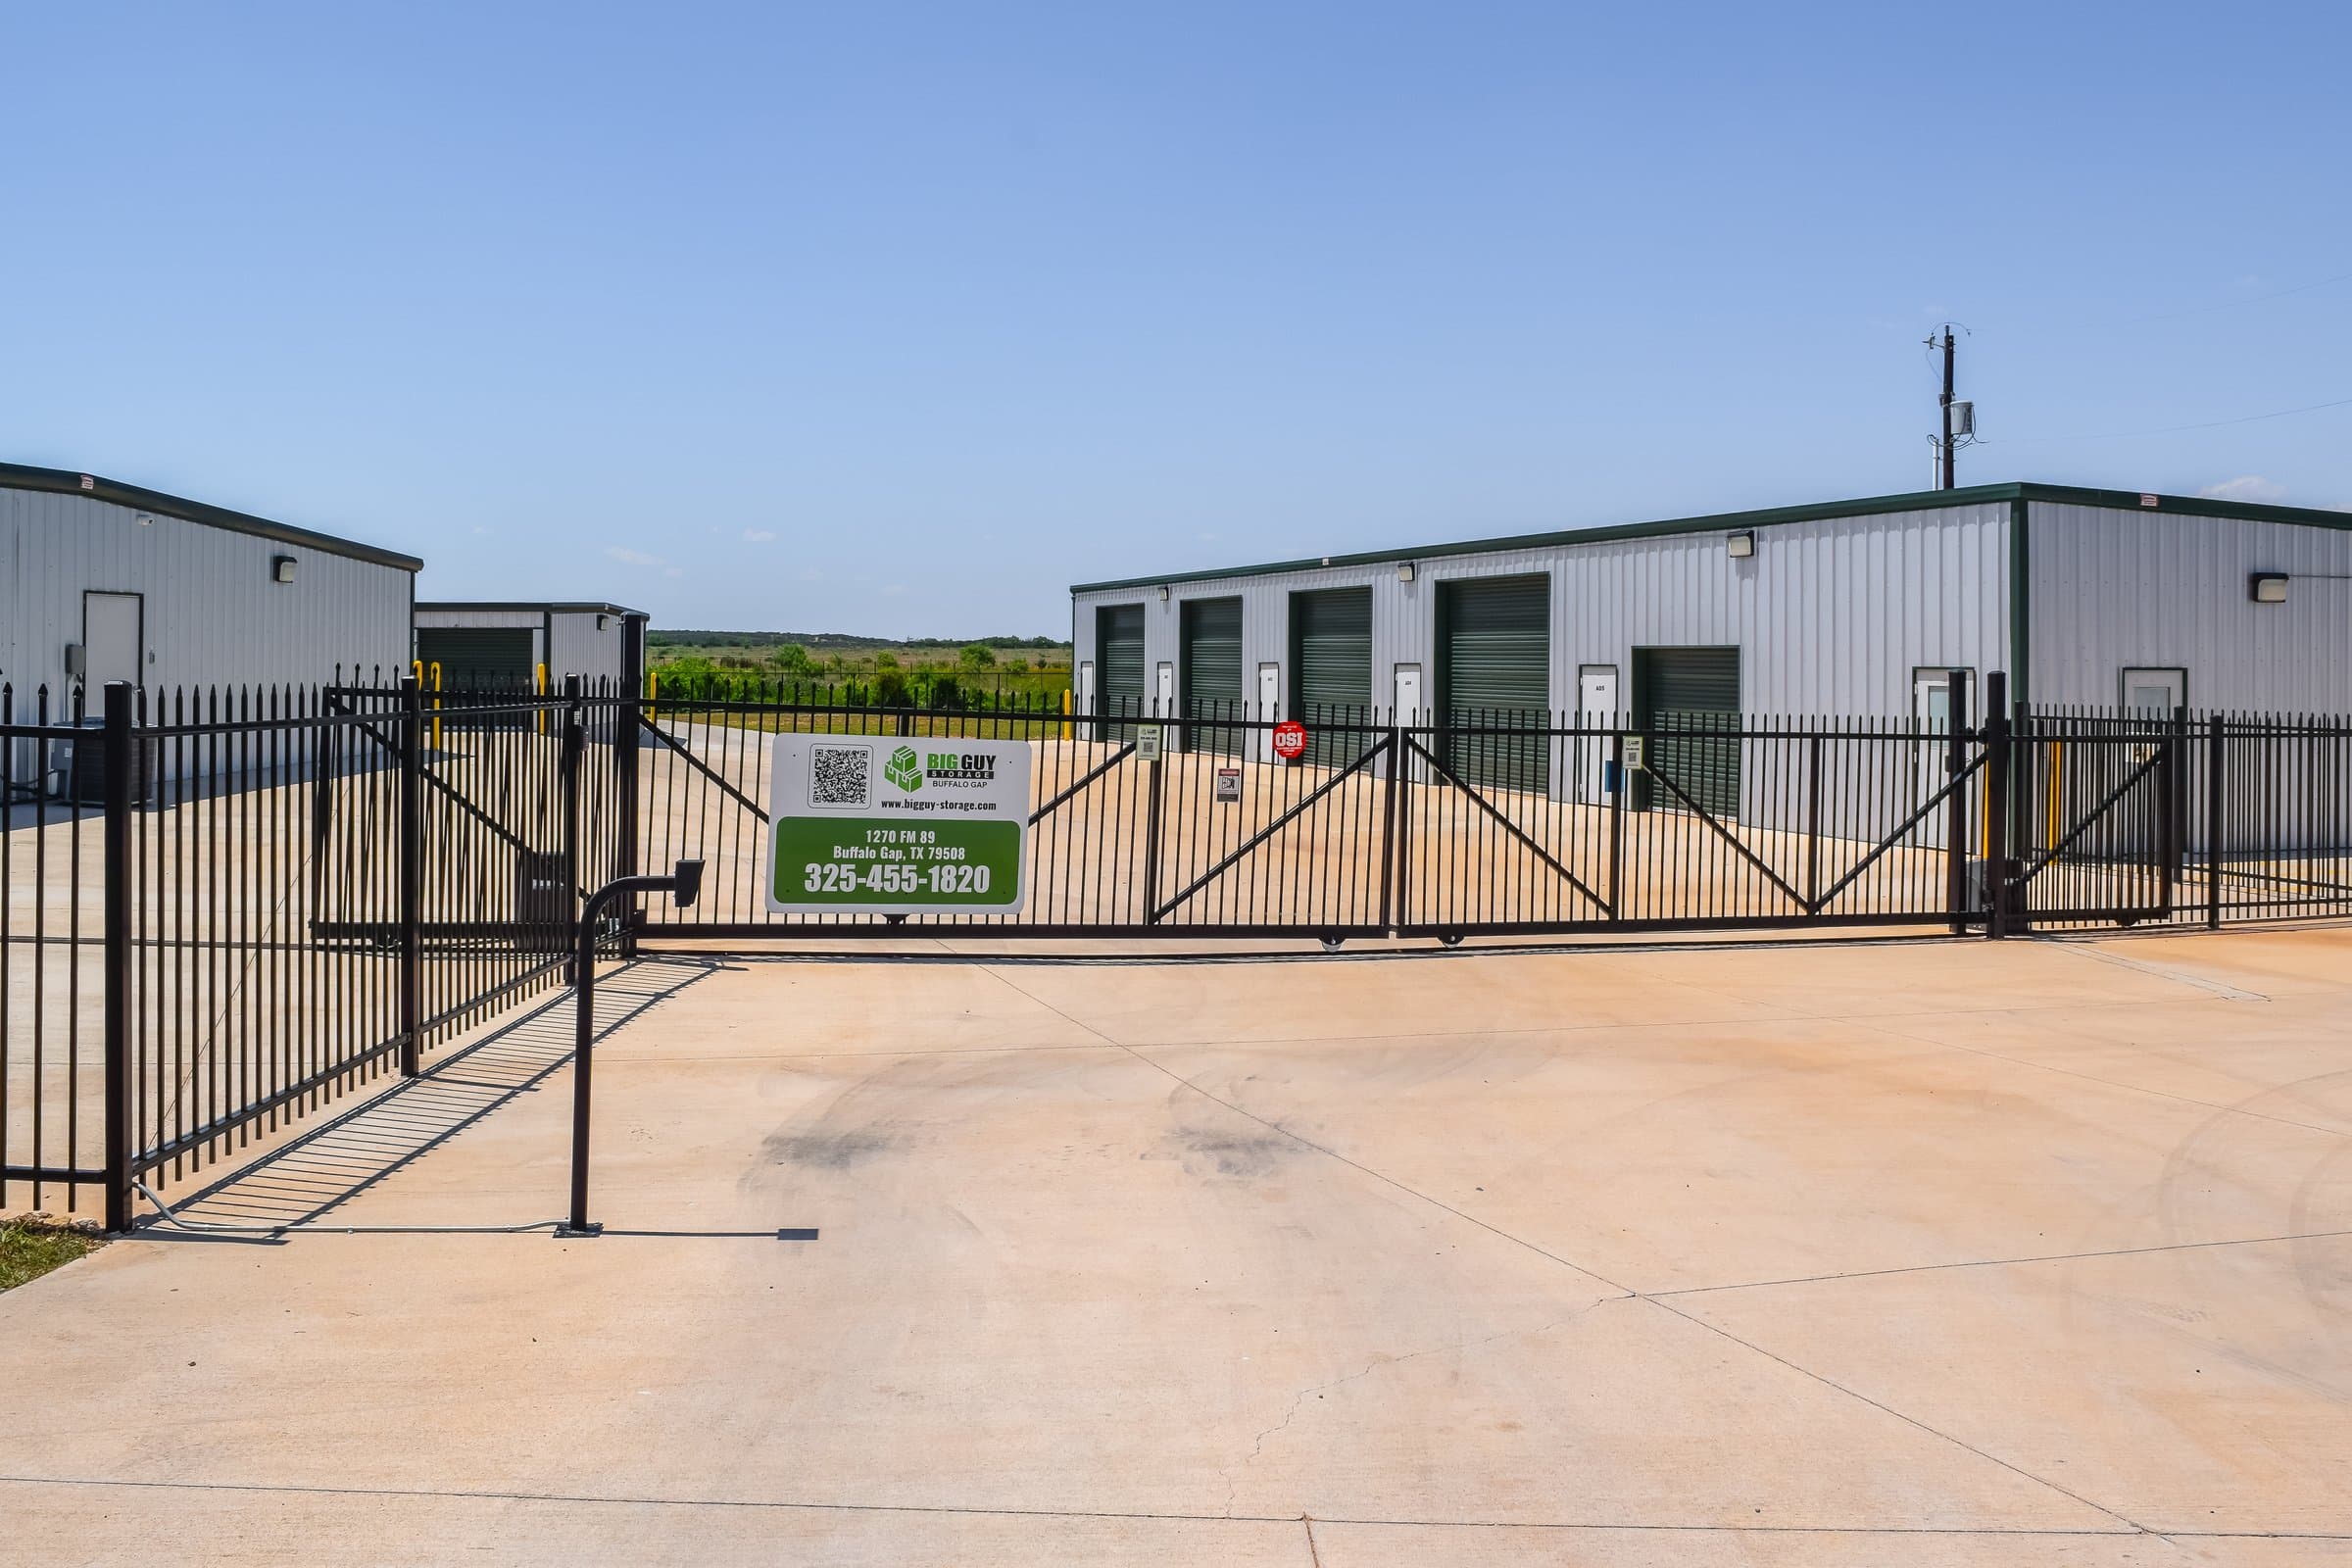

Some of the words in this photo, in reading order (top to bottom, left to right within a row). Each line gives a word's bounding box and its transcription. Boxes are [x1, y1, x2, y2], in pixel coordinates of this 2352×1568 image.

[1275, 731, 1303, 747] OSI
[927, 753, 958, 769] BIG
[960, 754, 997, 770] GUY
[931, 770, 990, 779] STORAGE
[881, 799, 997, 811] www.bigguy-storage.com
[865, 829, 897, 844] 1270
[900, 830, 916, 844] FM
[919, 830, 936, 844] 89
[833, 845, 876, 859] Buffalo
[880, 846, 906, 861] Gap,
[909, 846, 924, 859] TX
[928, 847, 965, 860] 79508
[804, 862, 991, 894] 325-455-1820
